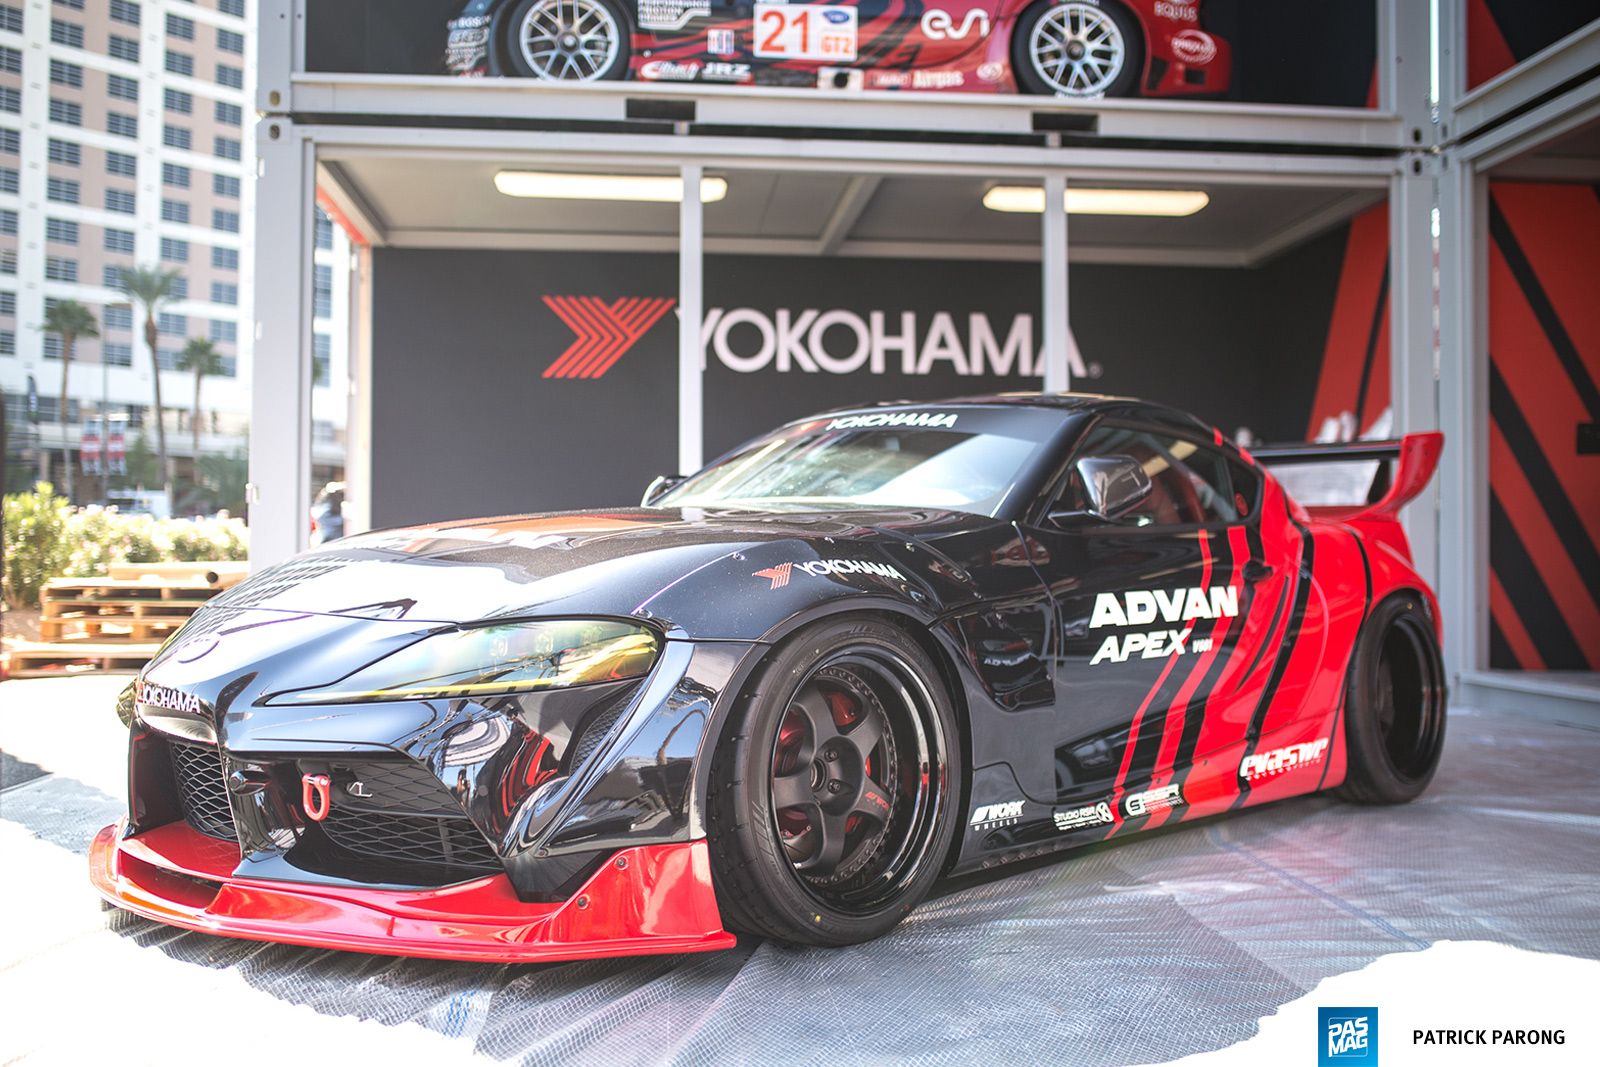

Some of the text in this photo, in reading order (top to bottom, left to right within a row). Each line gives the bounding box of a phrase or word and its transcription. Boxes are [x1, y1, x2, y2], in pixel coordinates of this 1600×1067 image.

[760, 10, 808, 53] 21
[821, 36, 852, 54] GT2
[702, 62, 751, 75] JRZ
[825, 413, 958, 431] YOKOHAMA
[793, 559, 907, 582] YOKOHAMA
[1089, 586, 1239, 629] ADVAN
[1089, 628, 1193, 666] APEX
[142, 684, 201, 714] YOKOHAMA
[986, 800, 1026, 820] WORK
[1053, 809, 1080, 823] STUDIO
